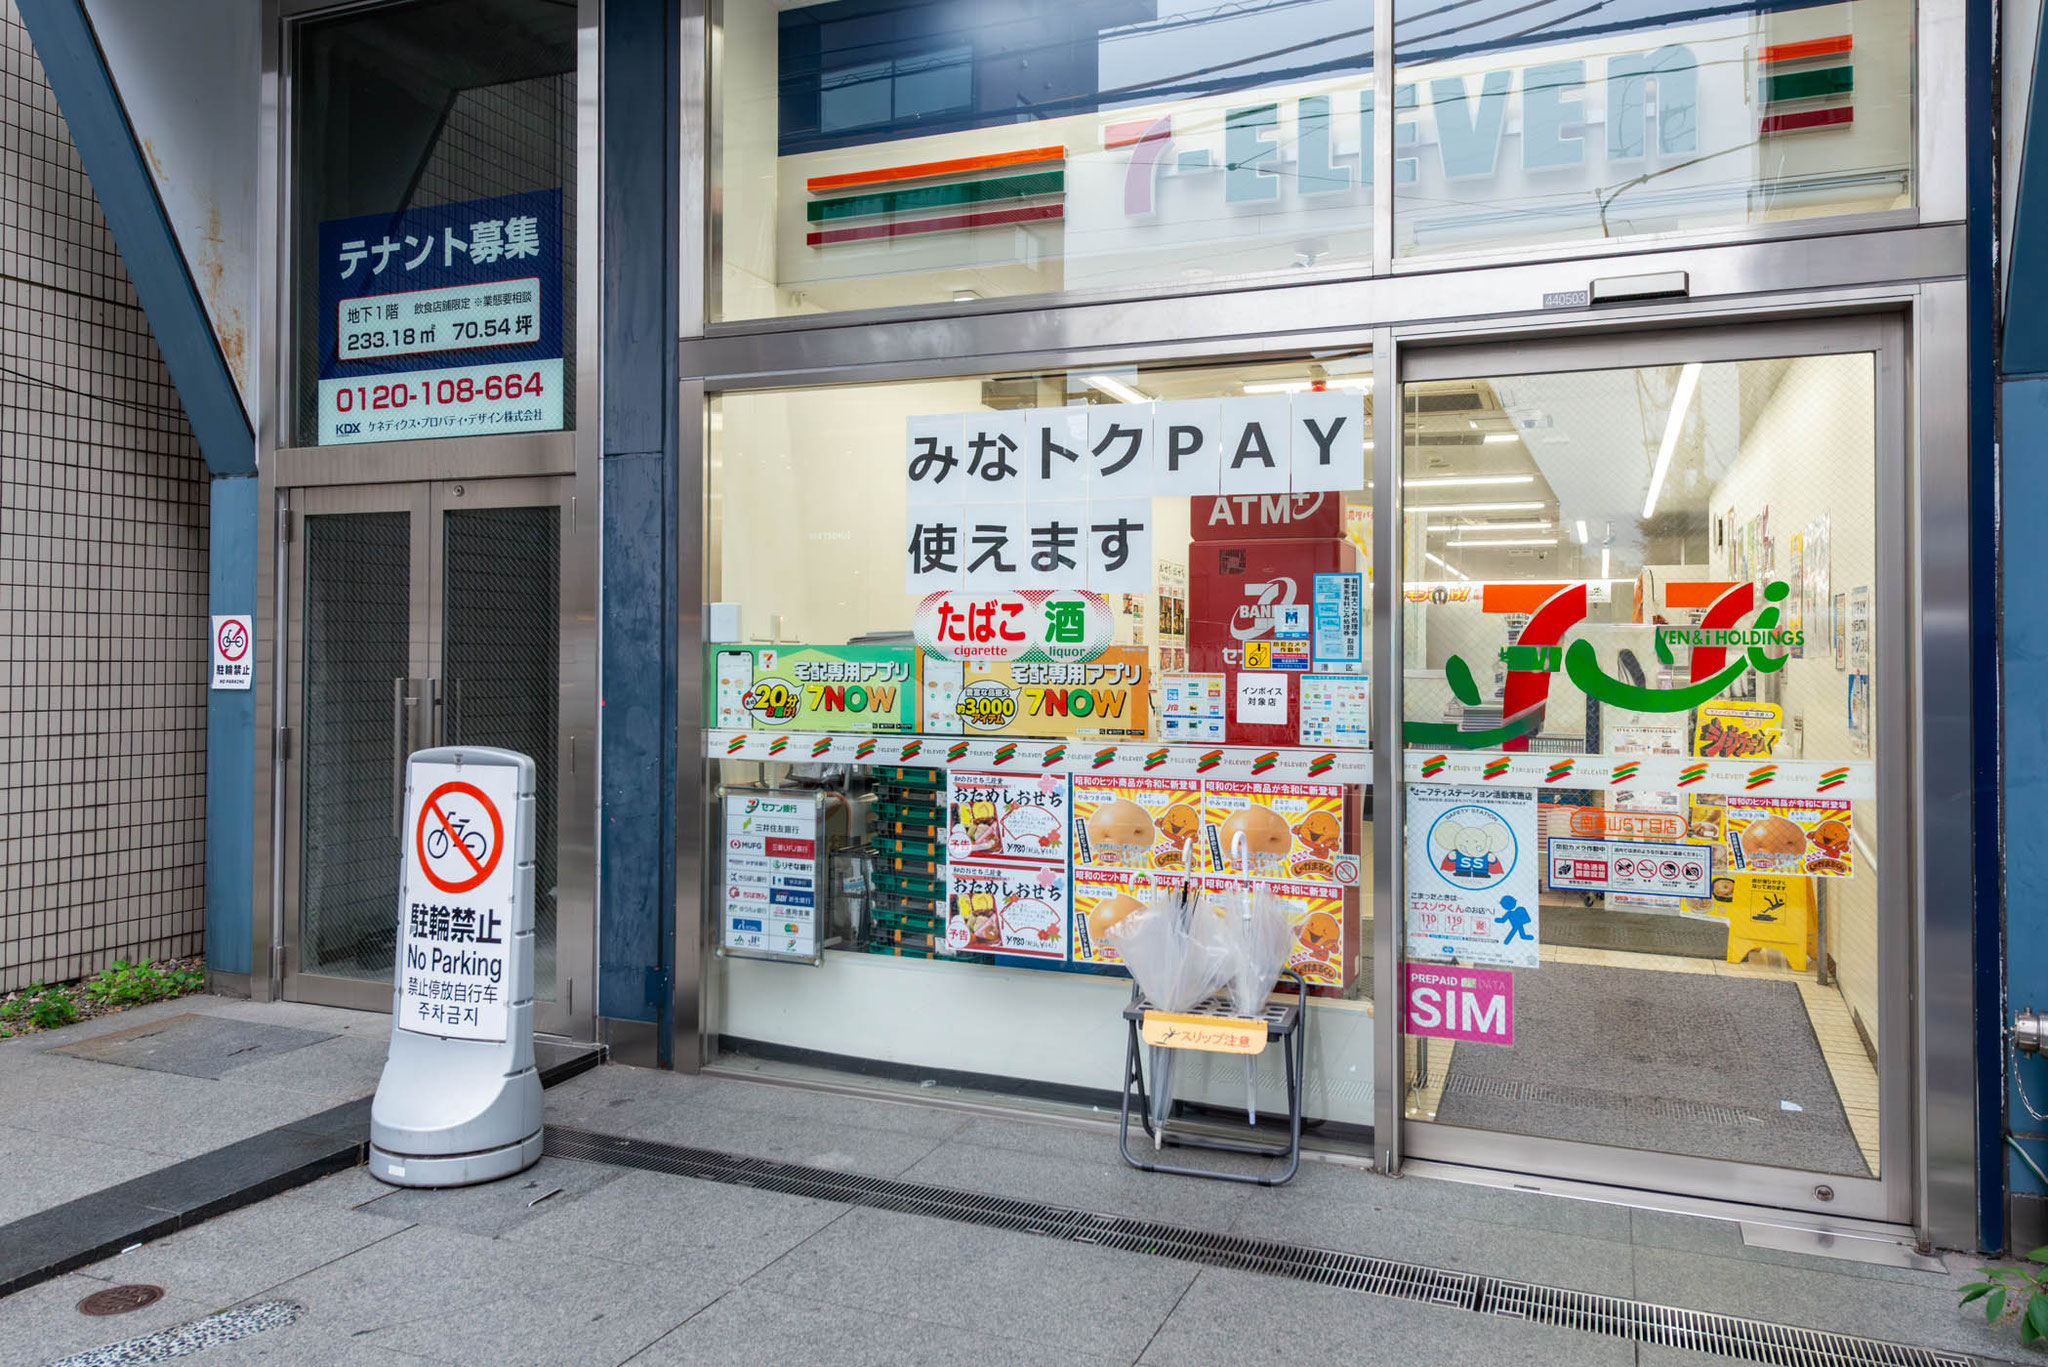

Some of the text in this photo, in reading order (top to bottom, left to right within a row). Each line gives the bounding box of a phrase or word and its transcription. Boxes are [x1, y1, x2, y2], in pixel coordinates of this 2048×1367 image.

[339, 216, 540, 280] テナント募集
[1545, 292, 1586, 307] 440503
[347, 304, 399, 324] 地下1階
[414, 297, 471, 315] 飲食店舗限定
[336, 372, 544, 413] 0120-108-664
[336, 423, 361, 435] KDX
[908, 416, 1347, 485] みなトクPAY
[908, 517, 1144, 575] 使えます
[1240, 605, 1275, 618] BAN
[937, 600, 1085, 643] たばこ 酒
[1715, 630, 1805, 645] HOLDINGS
[954, 645, 1086, 657] cigarette liquor
[216, 664, 250, 675] 駐輪禁止
[794, 661, 910, 682] 宅配専用アプリ
[1010, 663, 1142, 685] 宅配専用アプリ
[1242, 687, 1283, 696] インボイス
[1248, 697, 1277, 707] 対象店
[971, 713, 1006, 724] アイテム
[1075, 775, 1197, 790] 昭和のヒット商品が令和に新登場
[1206, 782, 1339, 796] 昭和のヒット商品が令和に新登場
[954, 787, 1063, 807] おためしおせち
[1729, 797, 1848, 809] 昭和のヒット商品が令和に新登場
[762, 802, 797, 813] セブン銀行
[1445, 808, 1498, 821] SAFETY STATION
[755, 823, 800, 834] 三井住友銀行
[742, 842, 762, 850] MUFG
[782, 862, 812, 872] りそな銀行
[1461, 857, 1484, 868] SS
[1076, 870, 1199, 887] 昭和のヒット商が和に新場
[953, 878, 1062, 901] おためしおせち
[1206, 879, 1338, 898] 昭和のが令和に新登場
[411, 903, 502, 944] 駐輪禁止
[1420, 914, 1462, 924] 110 119
[407, 944, 502, 983] No Parking
[1411, 973, 1458, 986] PREPAID
[408, 977, 498, 1004] 禁止停放自行车
[418, 1002, 479, 1026] 주차금지
[1410, 987, 1506, 1035] SIM
[1182, 1031, 1250, 1048] スリップ注意
